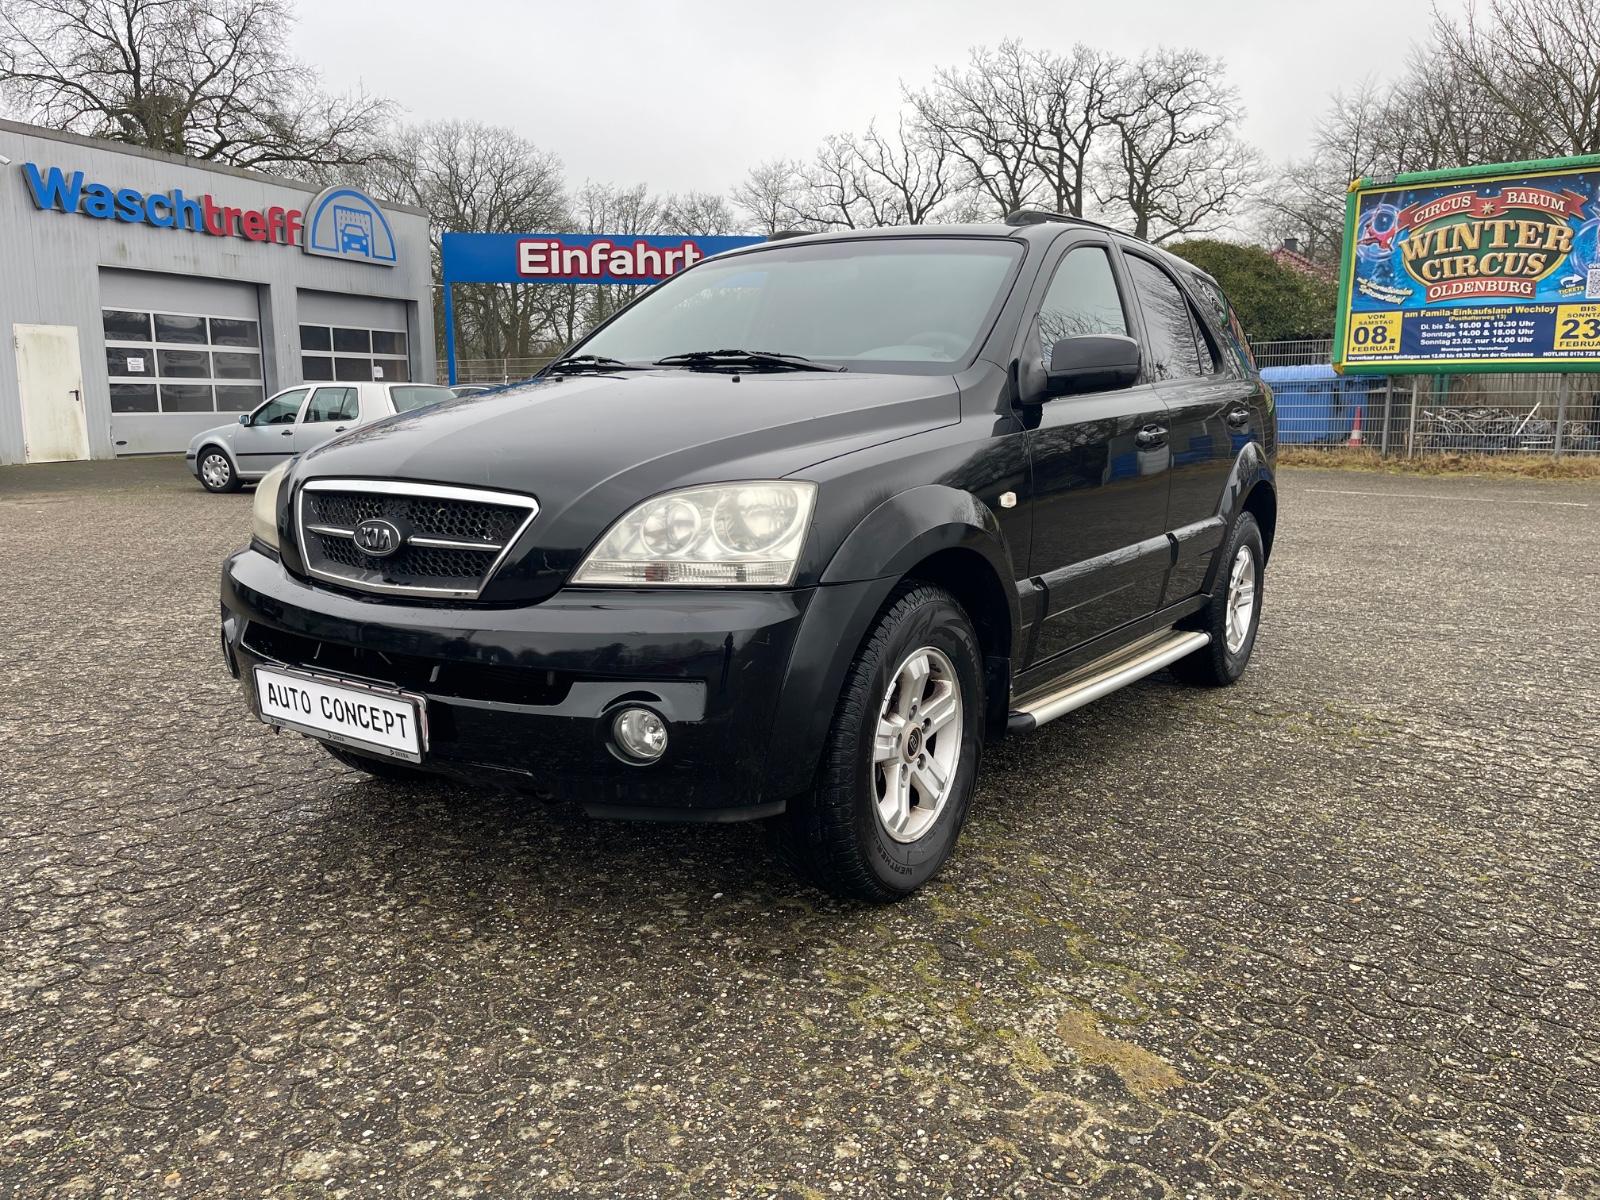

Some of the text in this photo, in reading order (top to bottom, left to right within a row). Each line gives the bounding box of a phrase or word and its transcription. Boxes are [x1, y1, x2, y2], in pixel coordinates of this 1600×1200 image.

[21, 161, 302, 246] Waschtreff
[1413, 191, 1566, 223] CIRCUS BARUM
[1398, 219, 1575, 262] WINTER
[518, 241, 701, 275] Einfahrt
[1421, 252, 1548, 281] CIRCUS
[1429, 281, 1533, 299] OLDENBURG
[1559, 286, 1585, 295] TICKETS
[1515, 305, 1556, 314] Wechloy
[1353, 325, 1396, 345] 08.
[1421, 331, 1456, 339] Sonntags
[1458, 329, 1481, 337] 14.00
[1492, 328, 1516, 336] 18.00
[1444, 322, 1456, 330] Sa.
[1493, 320, 1517, 328] 19.30
[1561, 318, 1600, 339] 23
[1491, 336, 1516, 344] 14.00
[361, 527, 392, 549] KIA
[267, 682, 407, 738] AUTO CONCEPT
